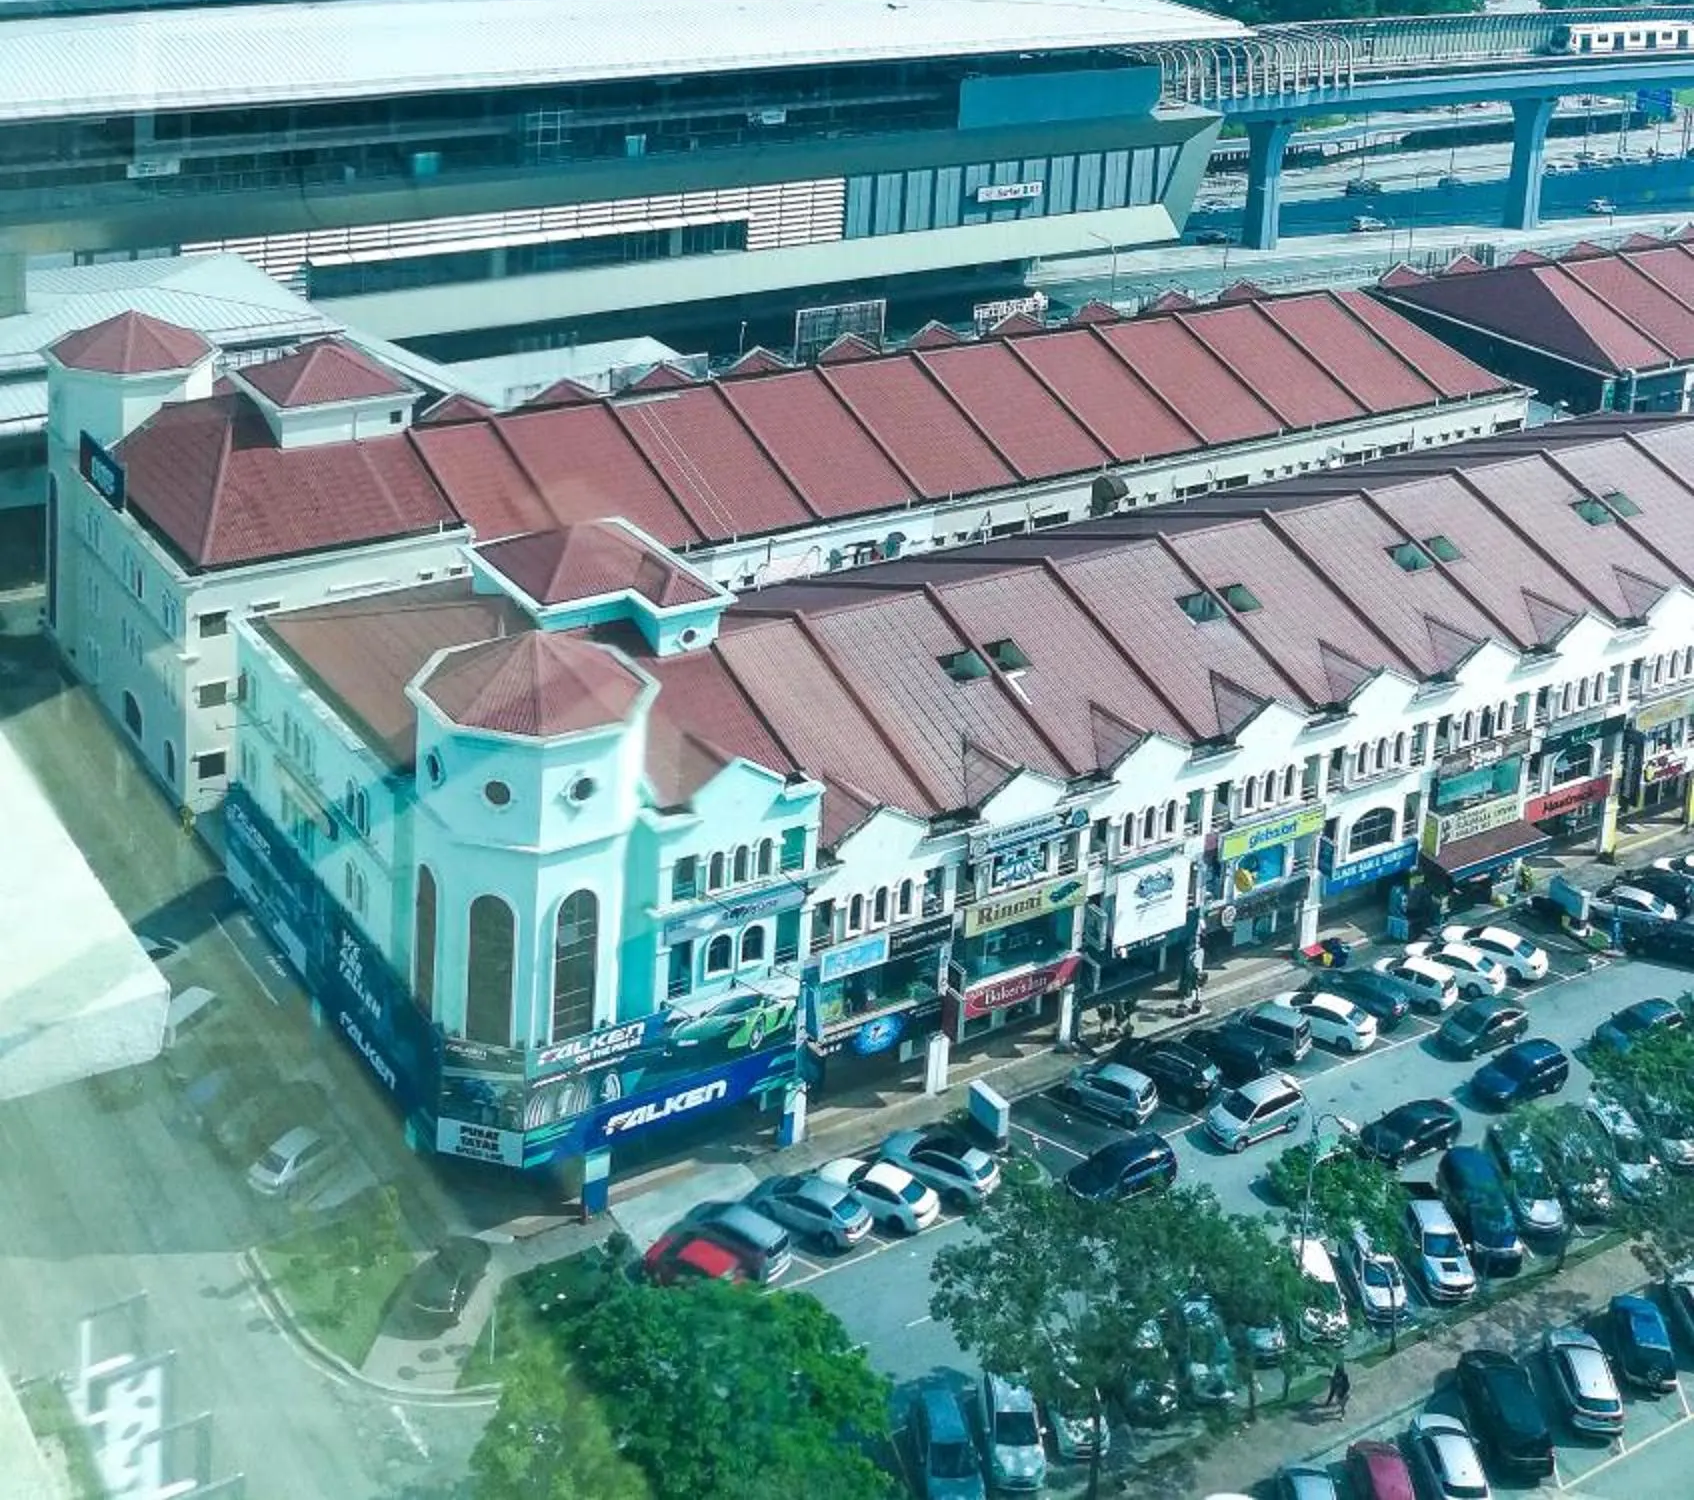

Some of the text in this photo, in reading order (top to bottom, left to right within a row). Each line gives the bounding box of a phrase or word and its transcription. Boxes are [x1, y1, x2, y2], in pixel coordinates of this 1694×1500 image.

[978, 889, 1042, 925] Rinnai
[340, 1011, 396, 1090] FALKEN
[537, 1022, 645, 1066] FALKEN
[603, 1080, 727, 1136] FALKEN
